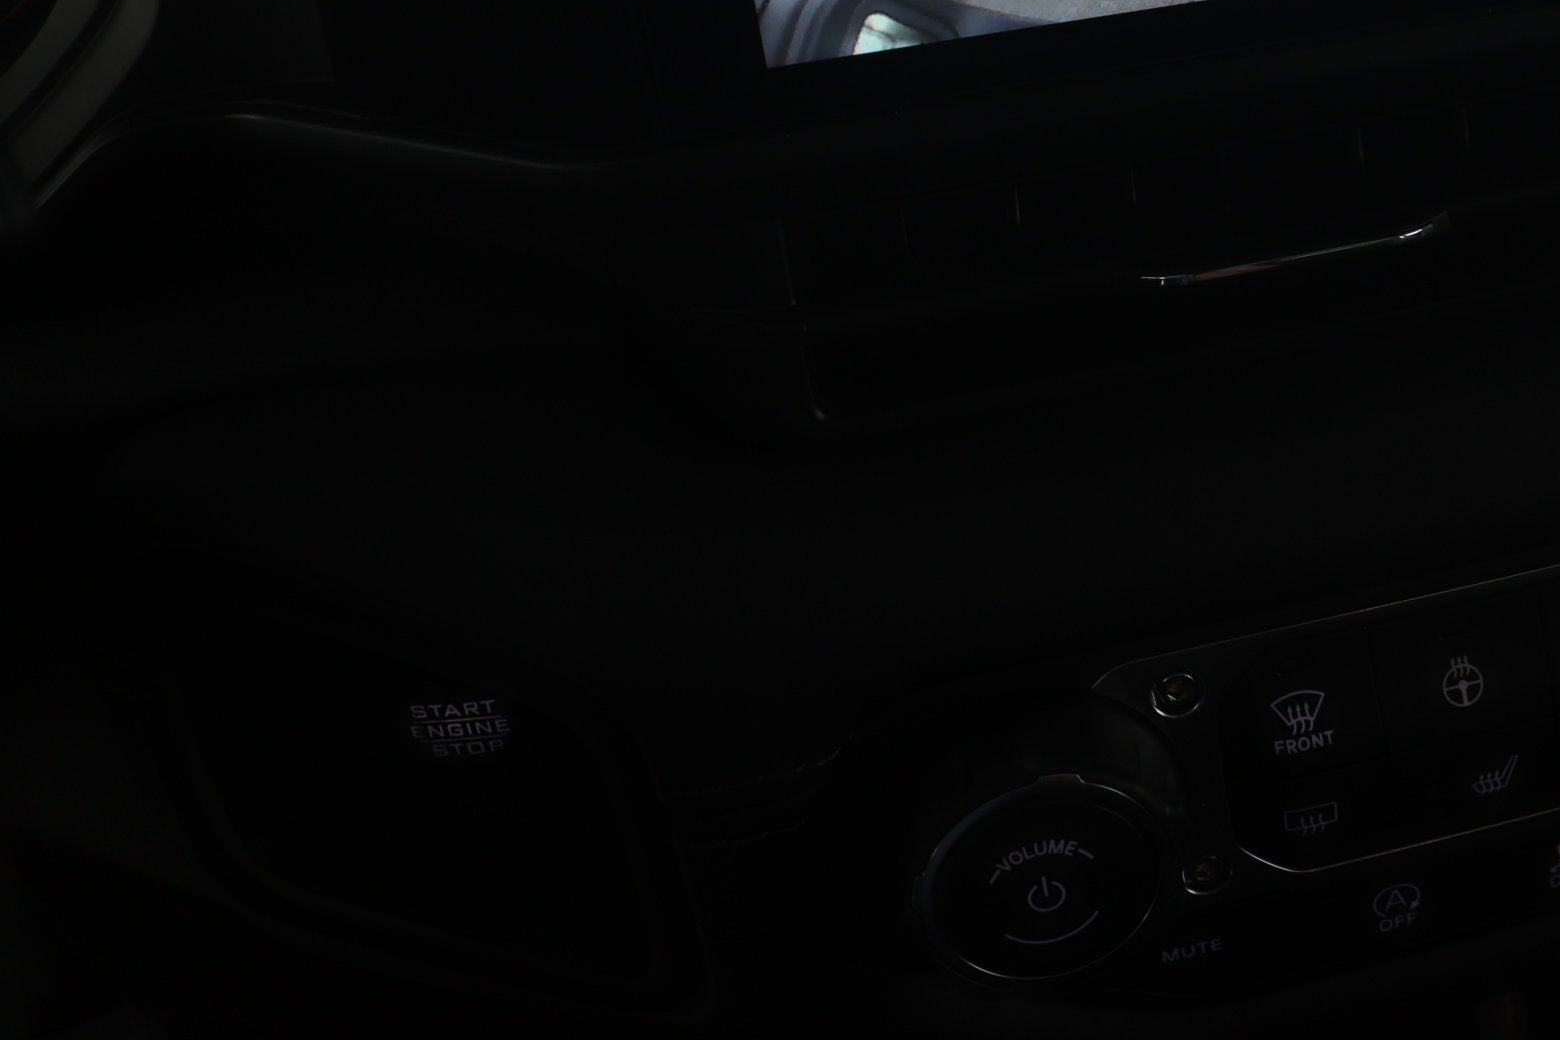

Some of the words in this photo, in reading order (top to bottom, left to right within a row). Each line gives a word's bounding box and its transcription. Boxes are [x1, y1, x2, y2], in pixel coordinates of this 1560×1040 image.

[410, 699, 496, 719] START
[410, 719, 511, 739] ENGINE
[431, 739, 505, 757] STOP
[1273, 729, 1335, 758] FRONT
[995, 839, 1079, 873] VOLUME
[1378, 911, 1419, 932] OFF
[1161, 937, 1224, 964] MUTE
